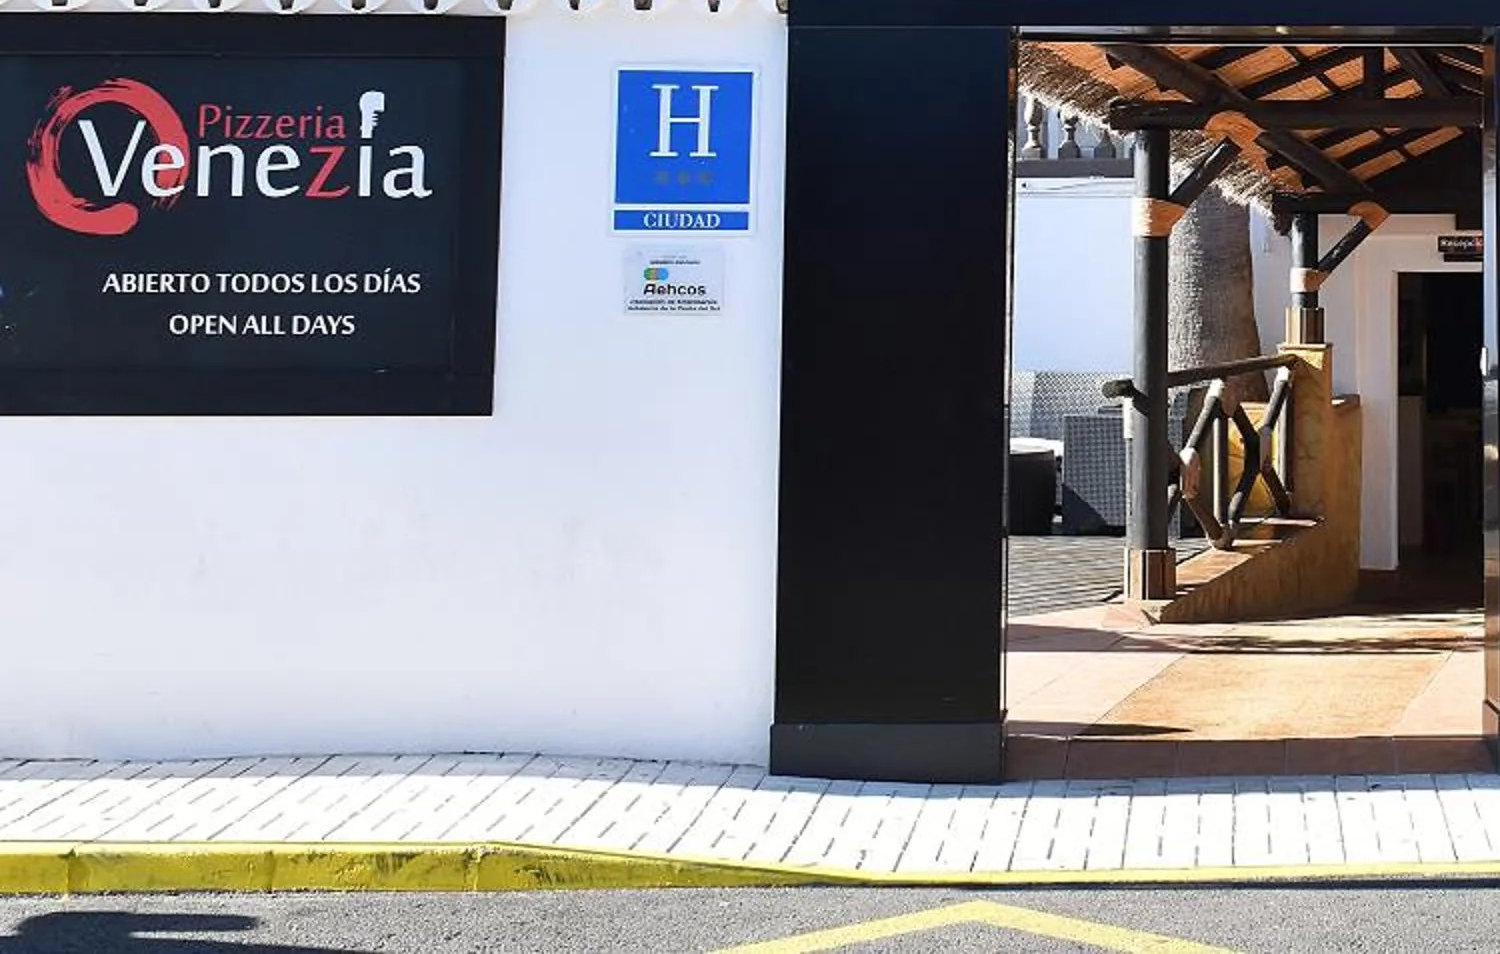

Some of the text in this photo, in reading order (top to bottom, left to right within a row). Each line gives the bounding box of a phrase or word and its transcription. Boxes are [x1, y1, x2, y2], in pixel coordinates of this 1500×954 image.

[199, 104, 347, 140] Pizzeria
[649, 84, 719, 157] H
[78, 91, 433, 199] Venezia
[643, 213, 721, 229] CIUDAD
[102, 267, 421, 295] ABIERTO TODOS LOS DÍAS
[643, 283, 706, 296] Aehcos
[169, 315, 355, 335] OPEN ALL DAYS
